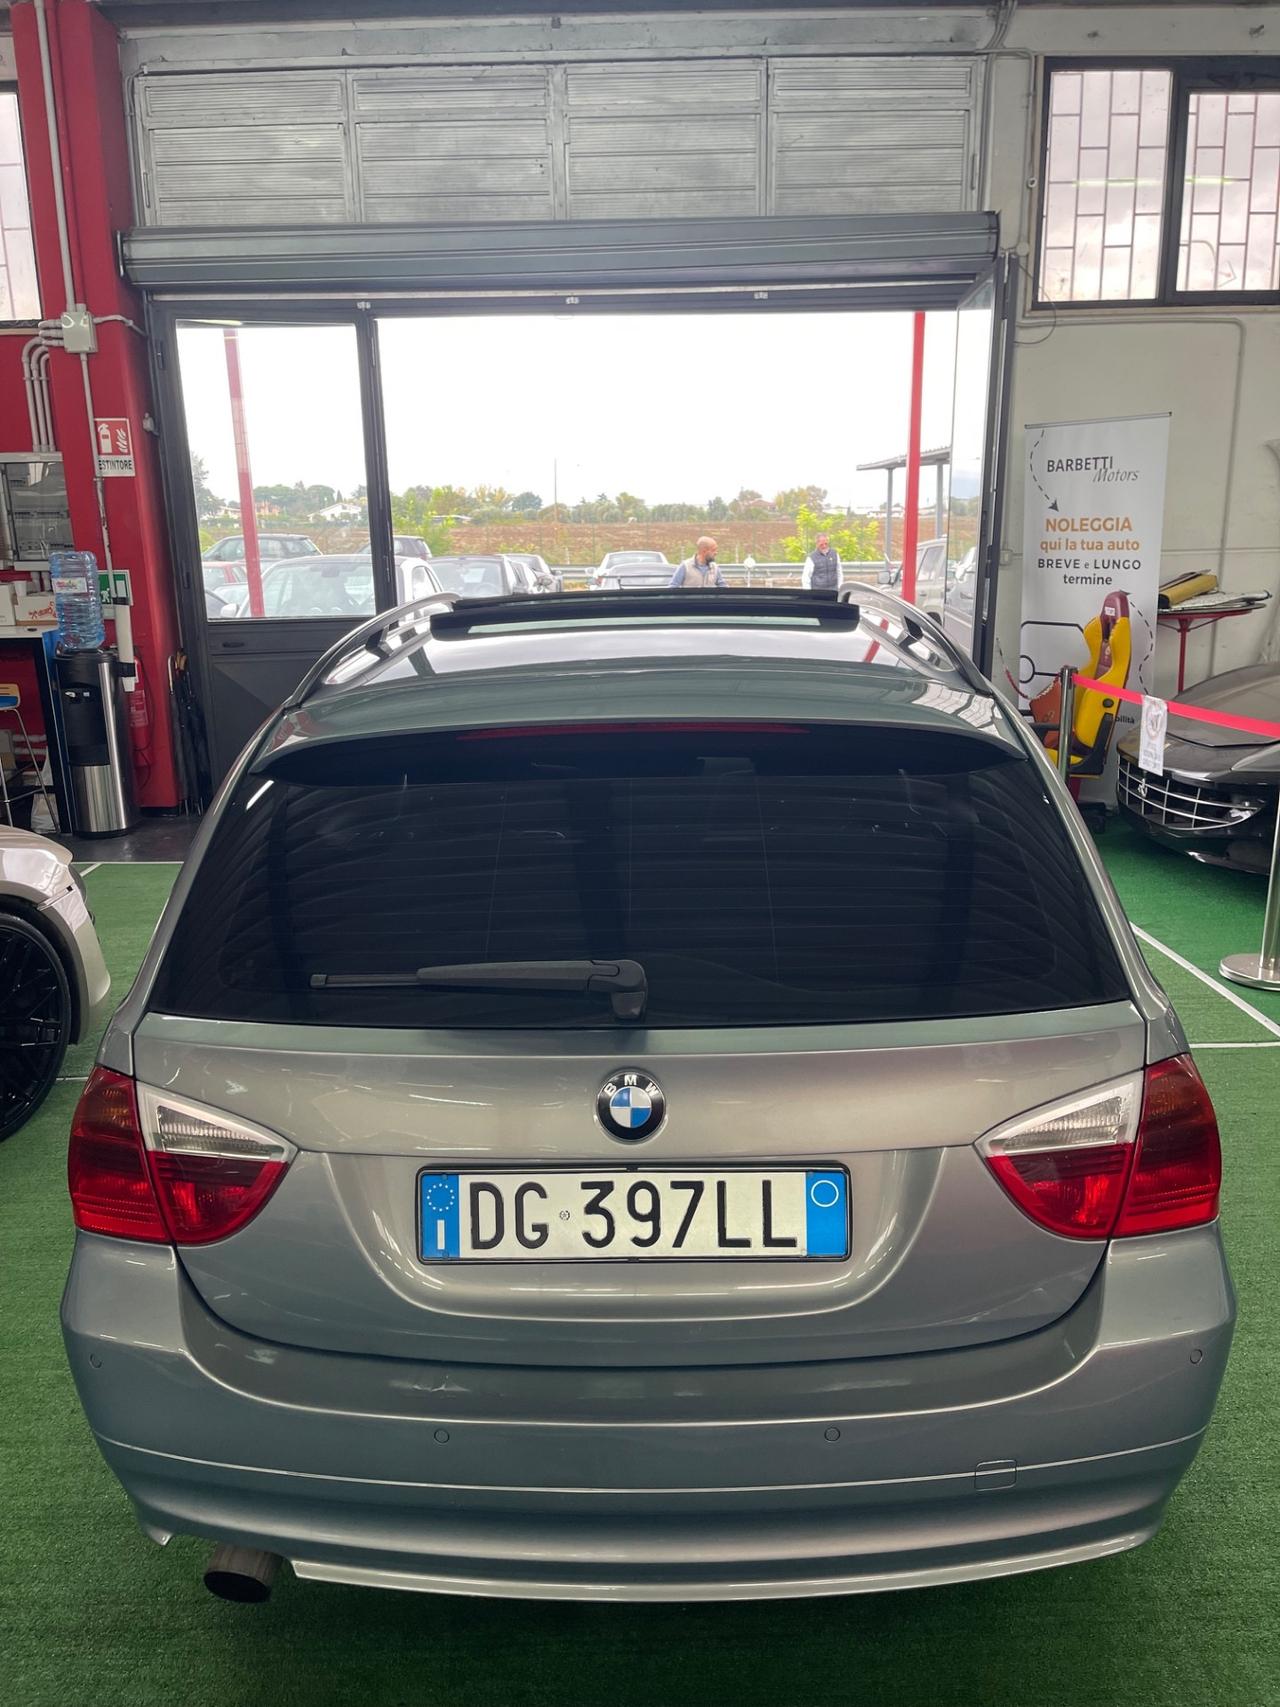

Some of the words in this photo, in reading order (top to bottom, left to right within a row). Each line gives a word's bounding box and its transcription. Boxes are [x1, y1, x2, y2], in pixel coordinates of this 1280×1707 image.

[98, 459, 132, 470] ESTINTORE
[1047, 456, 1113, 472] BARBETTI
[1093, 468, 1139, 482] Motors
[1045, 517, 1132, 532] NOLEGGIA
[1040, 538, 1061, 553] qui
[1065, 538, 1077, 551] la
[1080, 539, 1103, 550] tua
[1107, 539, 1140, 551] auto
[1038, 558, 1080, 568] BREVE
[1084, 561, 1090, 569] e
[1094, 559, 1141, 570] LUNGO
[1063, 573, 1113, 585] termine
[602, 1074, 660, 1098] BMW
[469, 1181, 550, 1250] DG
[580, 1179, 798, 1249] 397LL
